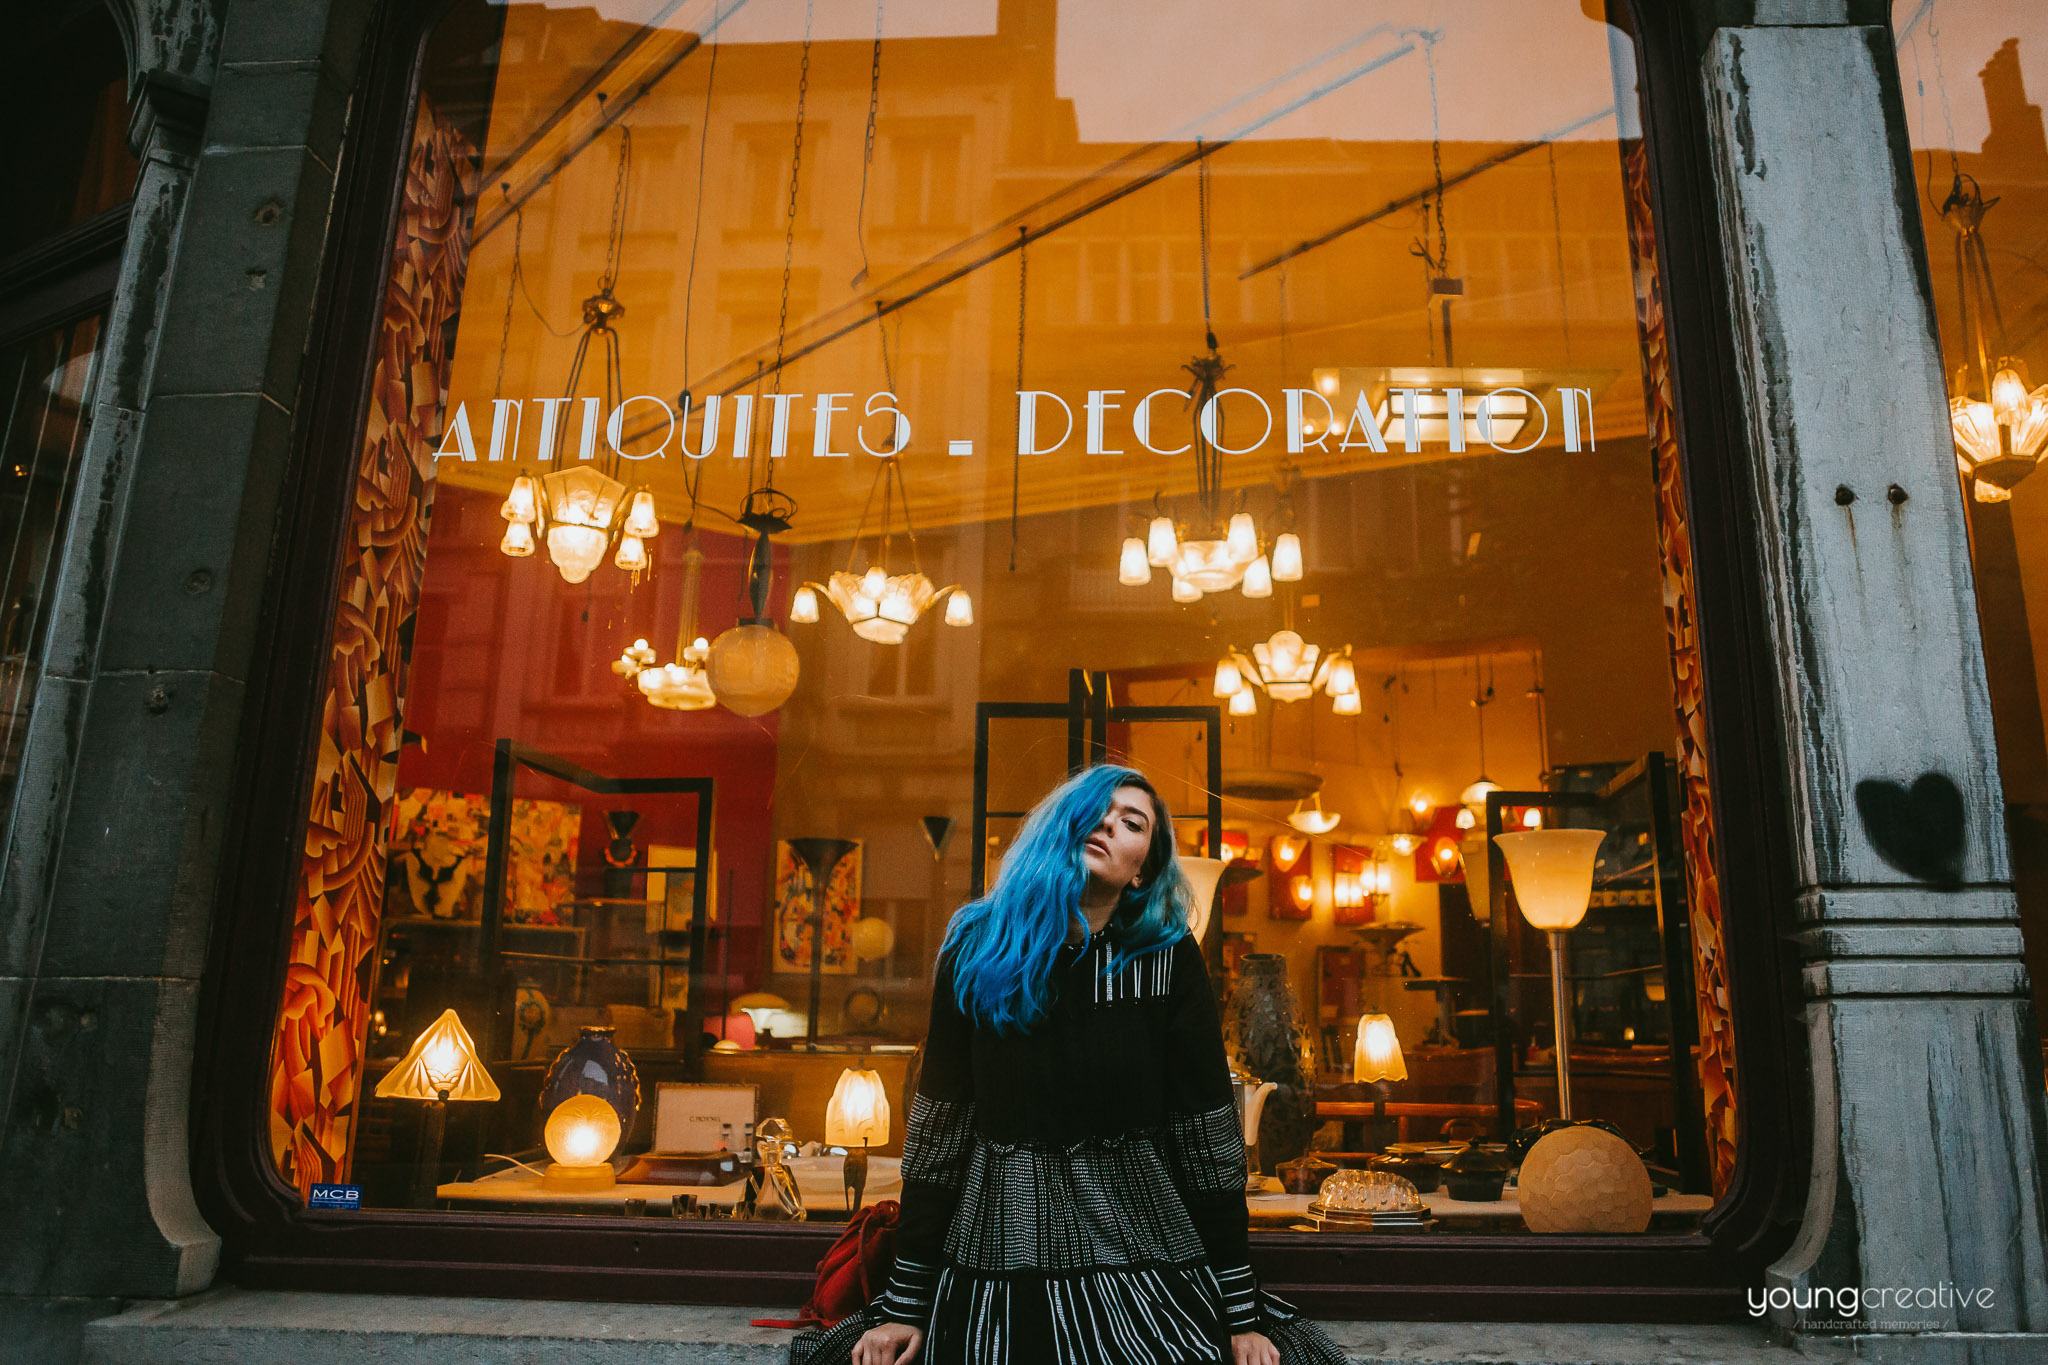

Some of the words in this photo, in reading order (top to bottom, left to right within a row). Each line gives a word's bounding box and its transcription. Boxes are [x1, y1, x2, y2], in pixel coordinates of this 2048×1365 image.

[433, 392, 910, 461] ANTIQUITES
[1016, 388, 1596, 455] DECORATION
[313, 1189, 359, 1199] MCB
